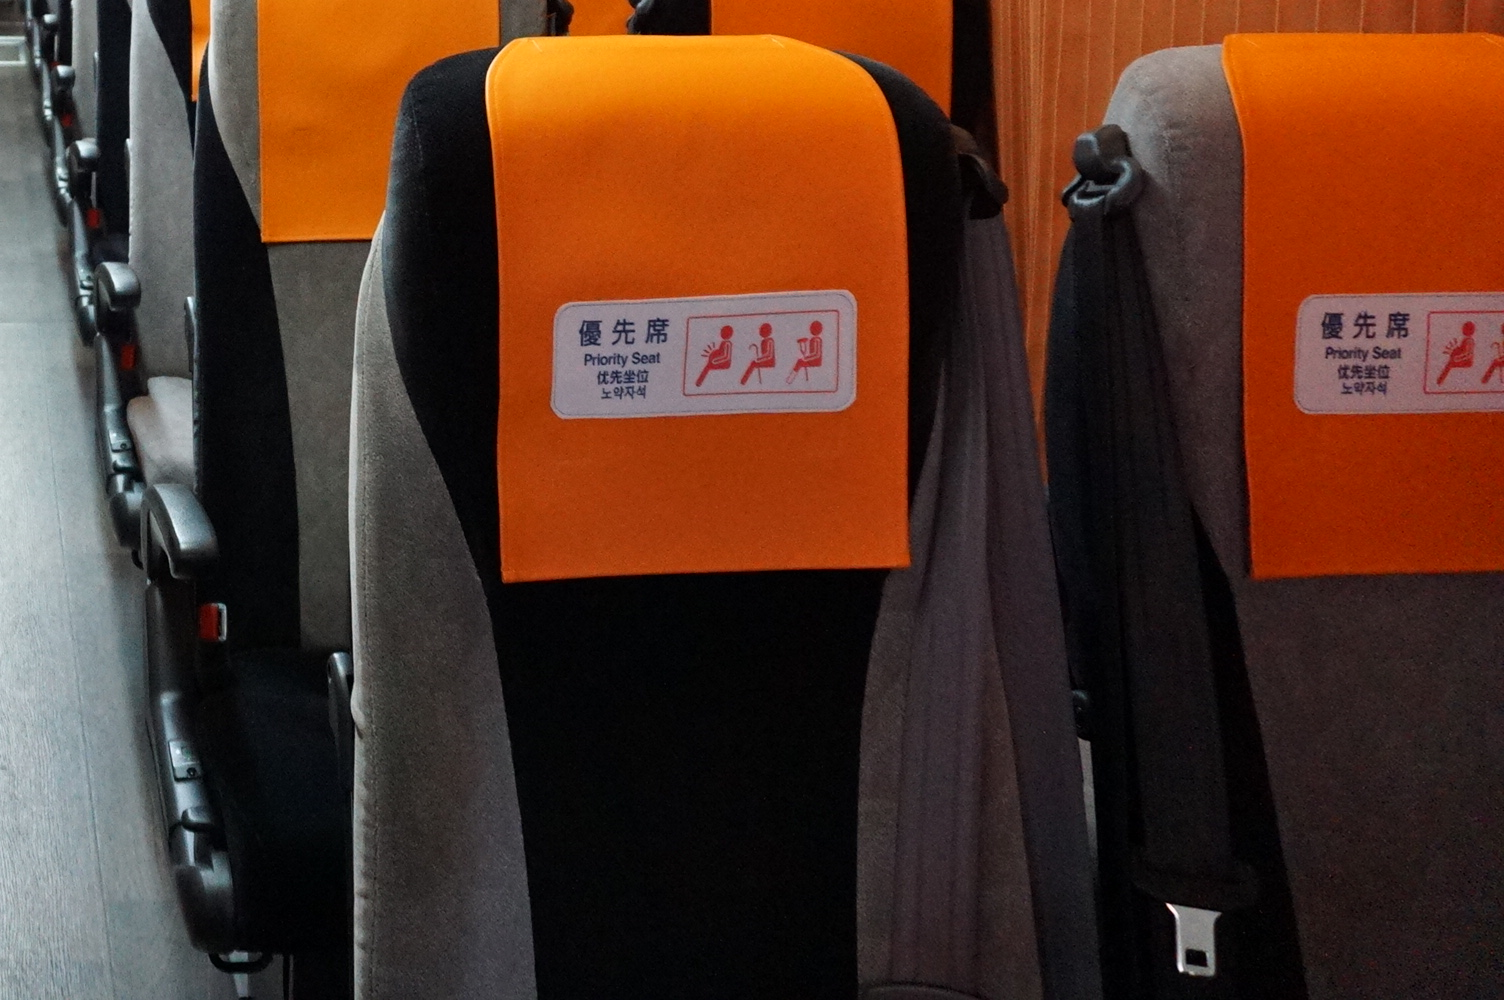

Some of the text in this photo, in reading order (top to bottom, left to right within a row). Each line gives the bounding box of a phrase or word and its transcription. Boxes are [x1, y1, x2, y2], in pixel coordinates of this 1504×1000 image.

[579, 317, 670, 346] 優先席
[1321, 312, 1410, 340] 優先席
[584, 351, 661, 368] Priority Seat
[1325, 346, 1402, 361] Priority Seat
[597, 369, 649, 384] 优先坐位
[600, 385, 647, 400] 노약자석
[1340, 381, 1388, 395] 노약자석
